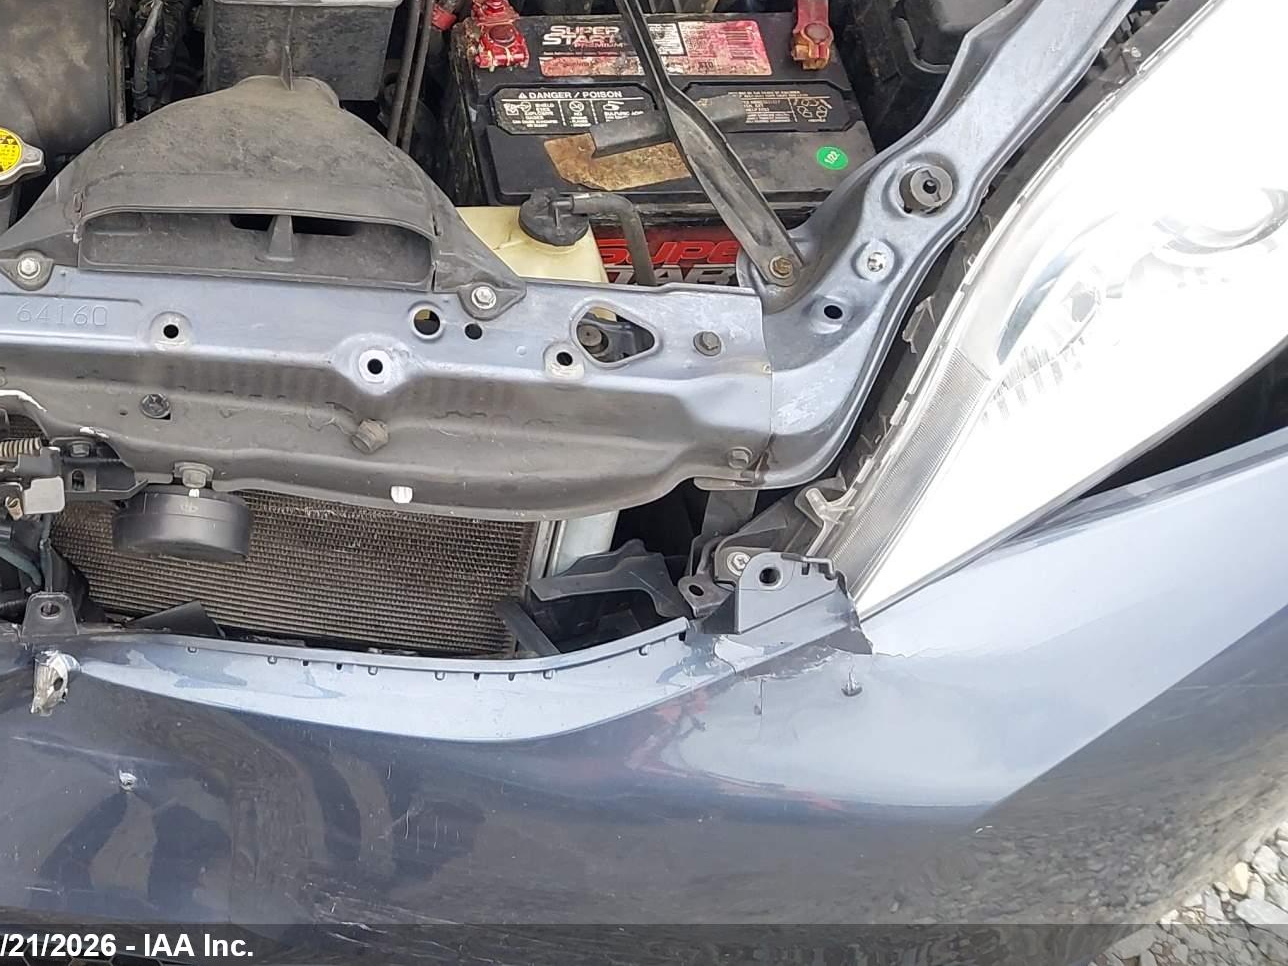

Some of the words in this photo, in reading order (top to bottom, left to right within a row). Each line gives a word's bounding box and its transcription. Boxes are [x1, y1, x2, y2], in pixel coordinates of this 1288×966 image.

[550, 25, 620, 35] SUPER
[528, 91, 572, 99] DANGER
[582, 90, 623, 99] POISON
[597, 239, 740, 264] SUPE
[16, 301, 109, 327] 64160
